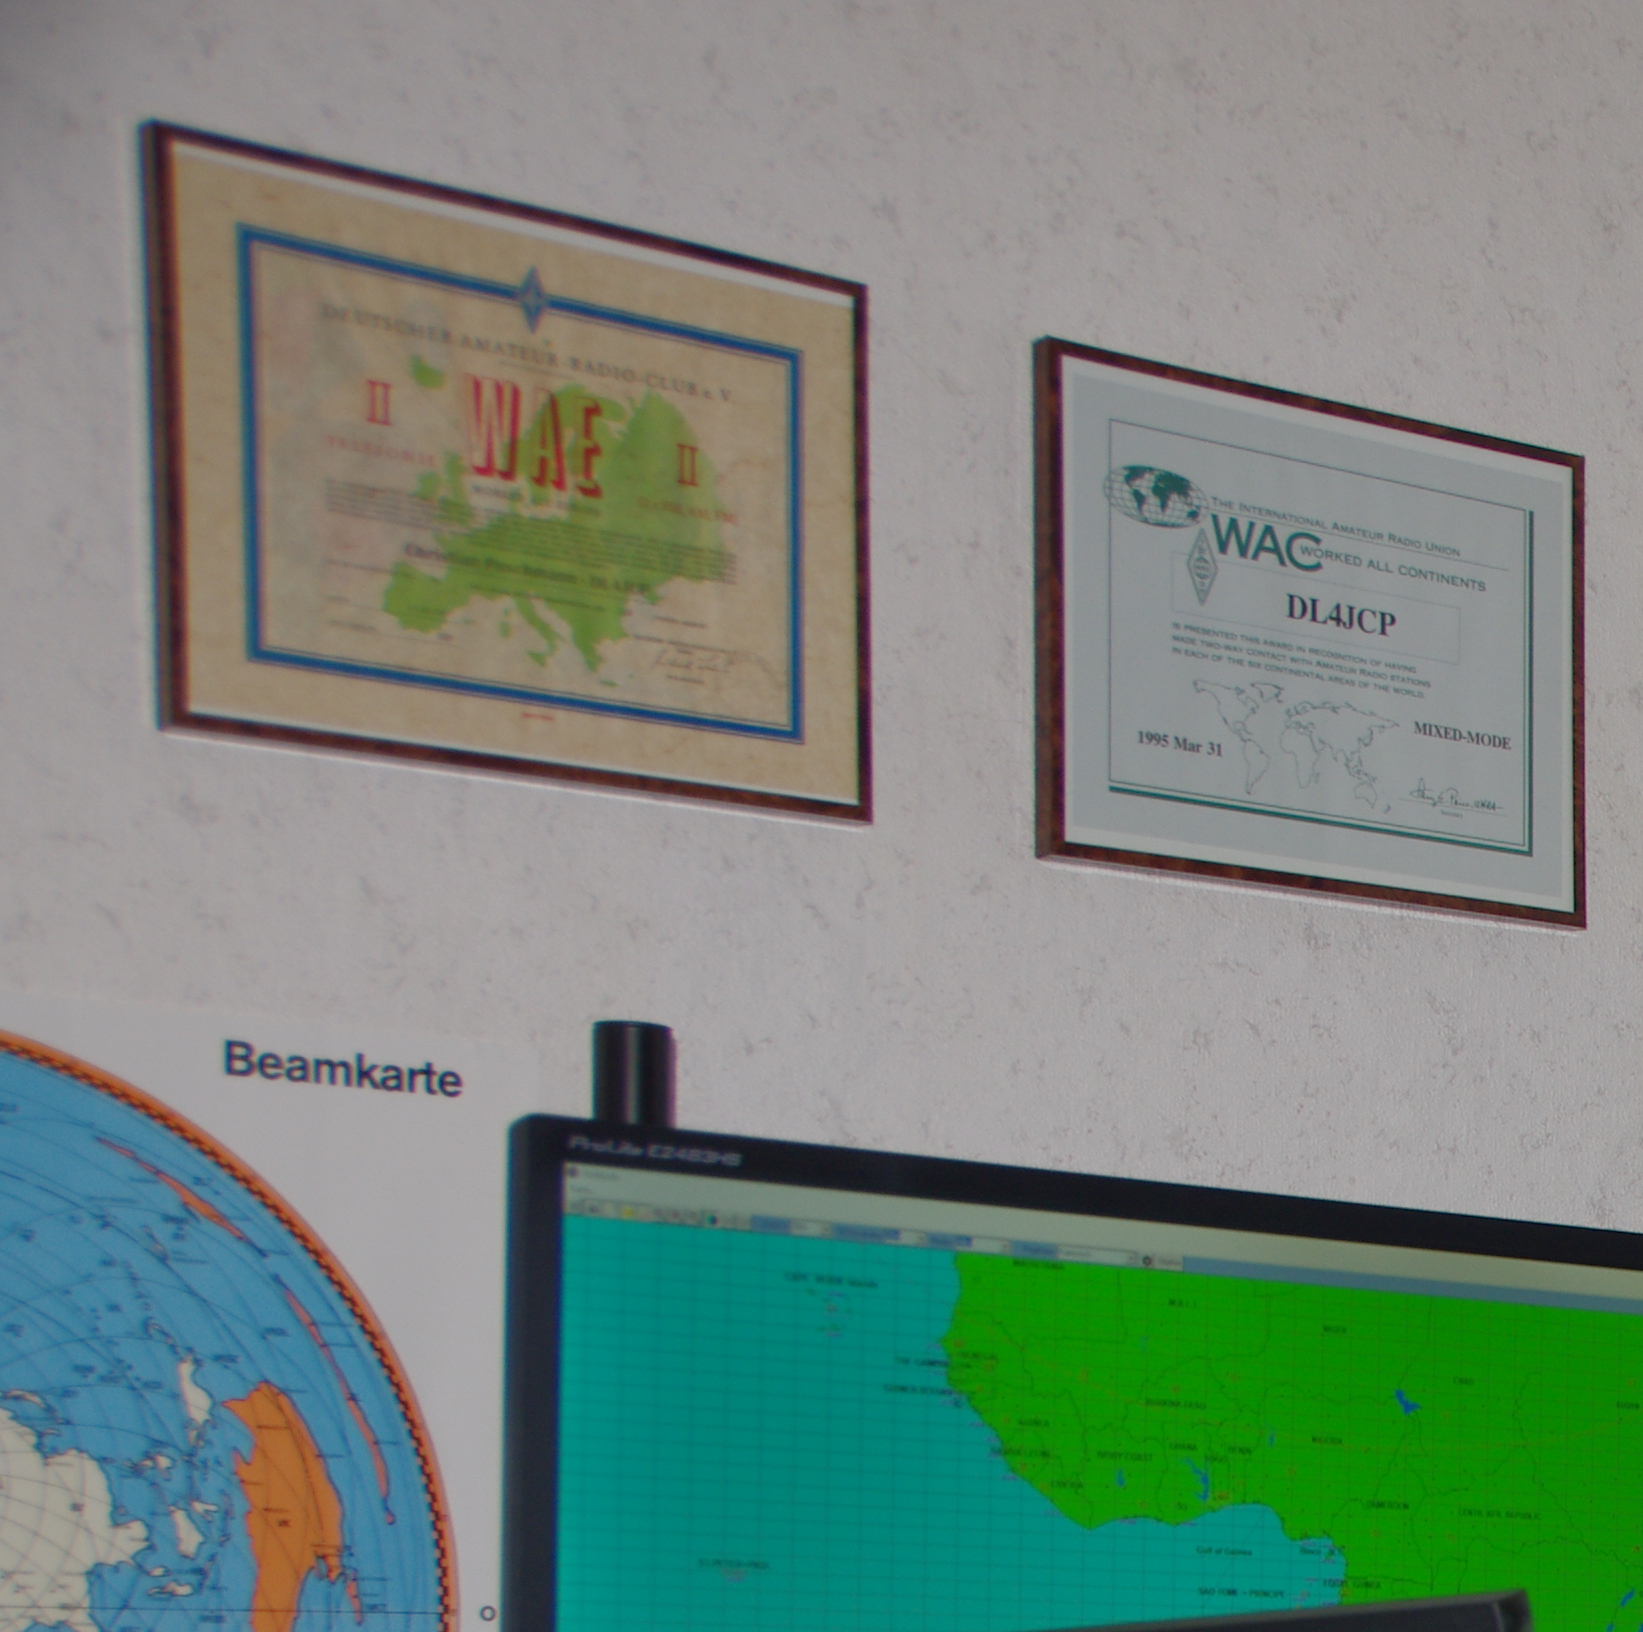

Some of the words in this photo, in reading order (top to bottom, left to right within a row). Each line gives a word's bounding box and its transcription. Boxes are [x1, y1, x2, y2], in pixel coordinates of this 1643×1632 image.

[464, 373, 603, 498] WAE
[1210, 513, 1323, 572] WAC
[1211, 497, 1234, 509] THE
[1239, 503, 1328, 530] INTERNATIONAL
[1332, 522, 1384, 542] AMATEUR
[1388, 533, 1422, 550] RADIO
[1426, 542, 1462, 558] UNION
[1300, 545, 1363, 568] WORKED
[1367, 559, 1394, 573] ALL
[1398, 565, 1487, 592] CONTINENTS
[1287, 593, 1397, 636] DL4JCP
[1184, 624, 1238, 641] PRESENTED
[1241, 634, 1261, 644] THIS
[1263, 639, 1293, 651] AWARD
[1308, 647, 1367, 665] RECOGNITION
[1384, 662, 1417, 674] HAVING
[1137, 731, 1170, 750] 1995
[1173, 737, 1203, 754] Mar
[1206, 741, 1224, 758] 31
[1414, 720, 1512, 751] MIXED-MODE
[222, 1039, 464, 1098] Beamkarte
